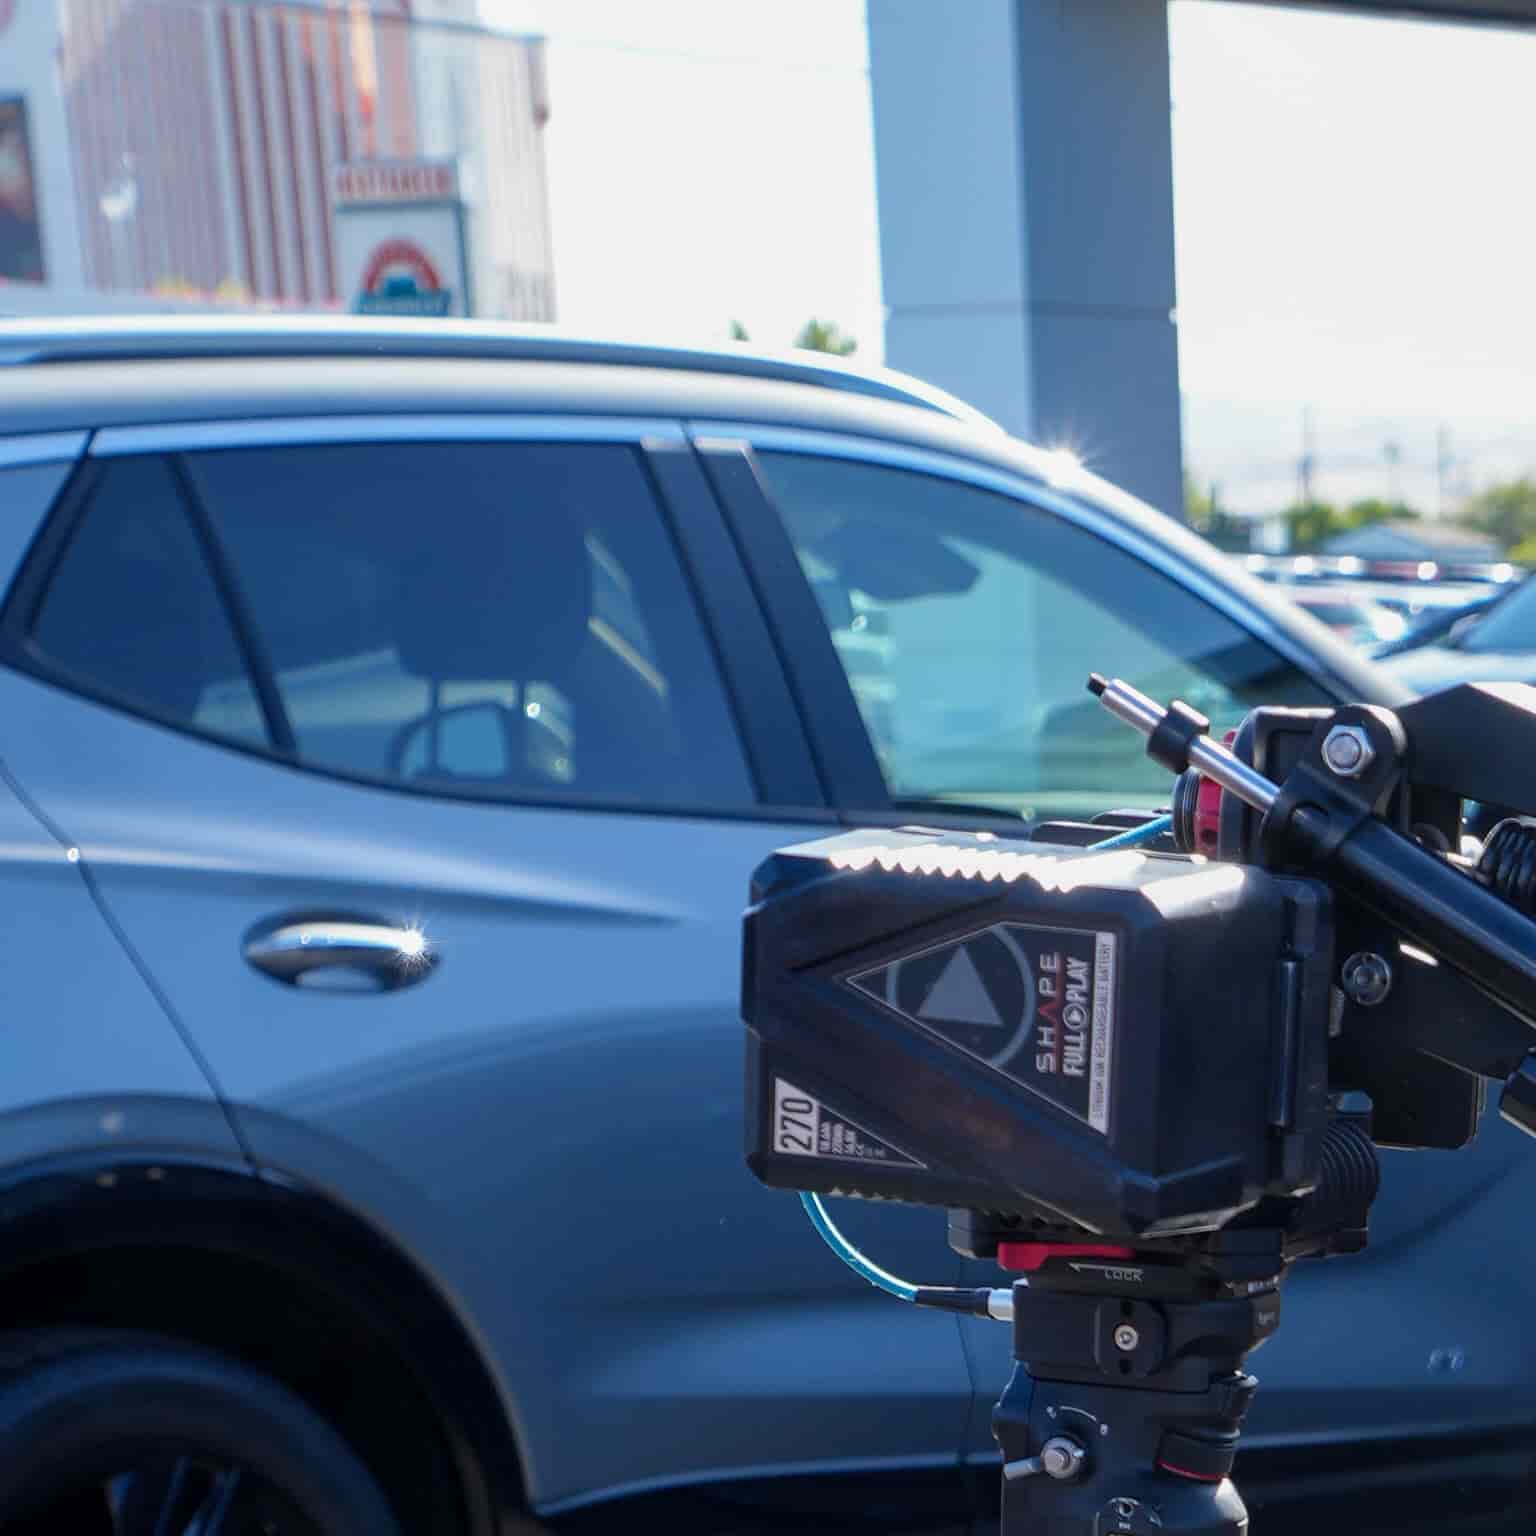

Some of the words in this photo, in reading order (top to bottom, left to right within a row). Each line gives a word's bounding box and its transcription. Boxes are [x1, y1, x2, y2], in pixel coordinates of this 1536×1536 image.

[1036, 951, 1059, 1074] SHAPE
[782, 1097, 813, 1151] 270
[1104, 1269, 1144, 1282] LOCK
